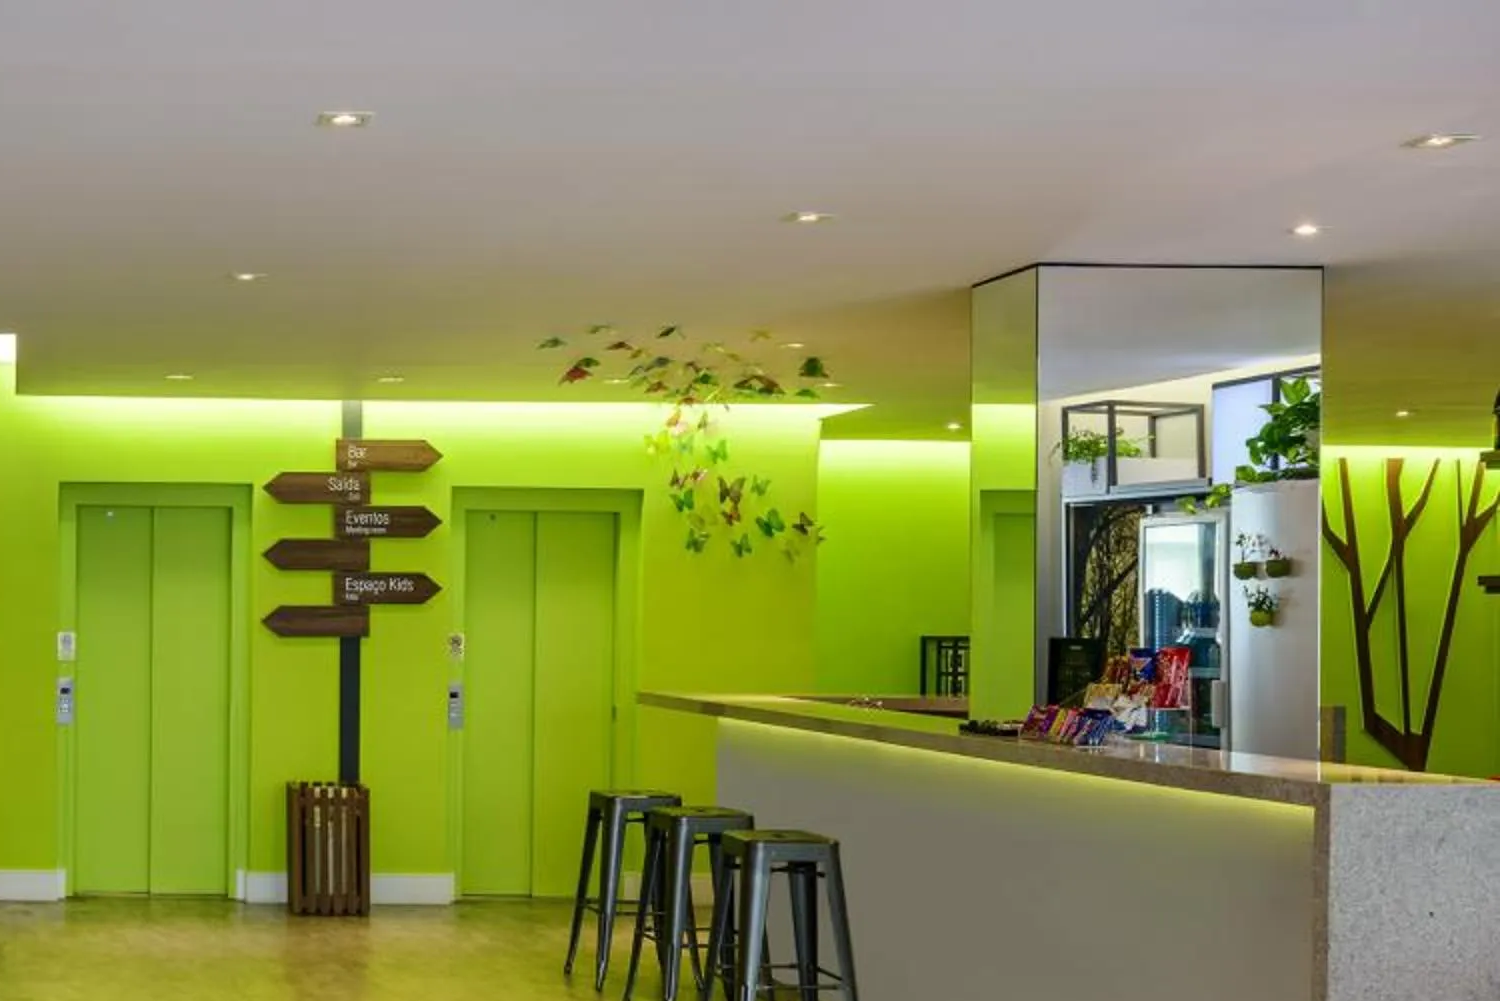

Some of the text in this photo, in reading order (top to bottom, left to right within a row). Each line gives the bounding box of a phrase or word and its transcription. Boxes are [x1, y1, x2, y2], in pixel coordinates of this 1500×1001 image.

[347, 444, 368, 459] Bar
[345, 510, 390, 526] Eventos
[345, 577, 415, 595] Espaço Kids
